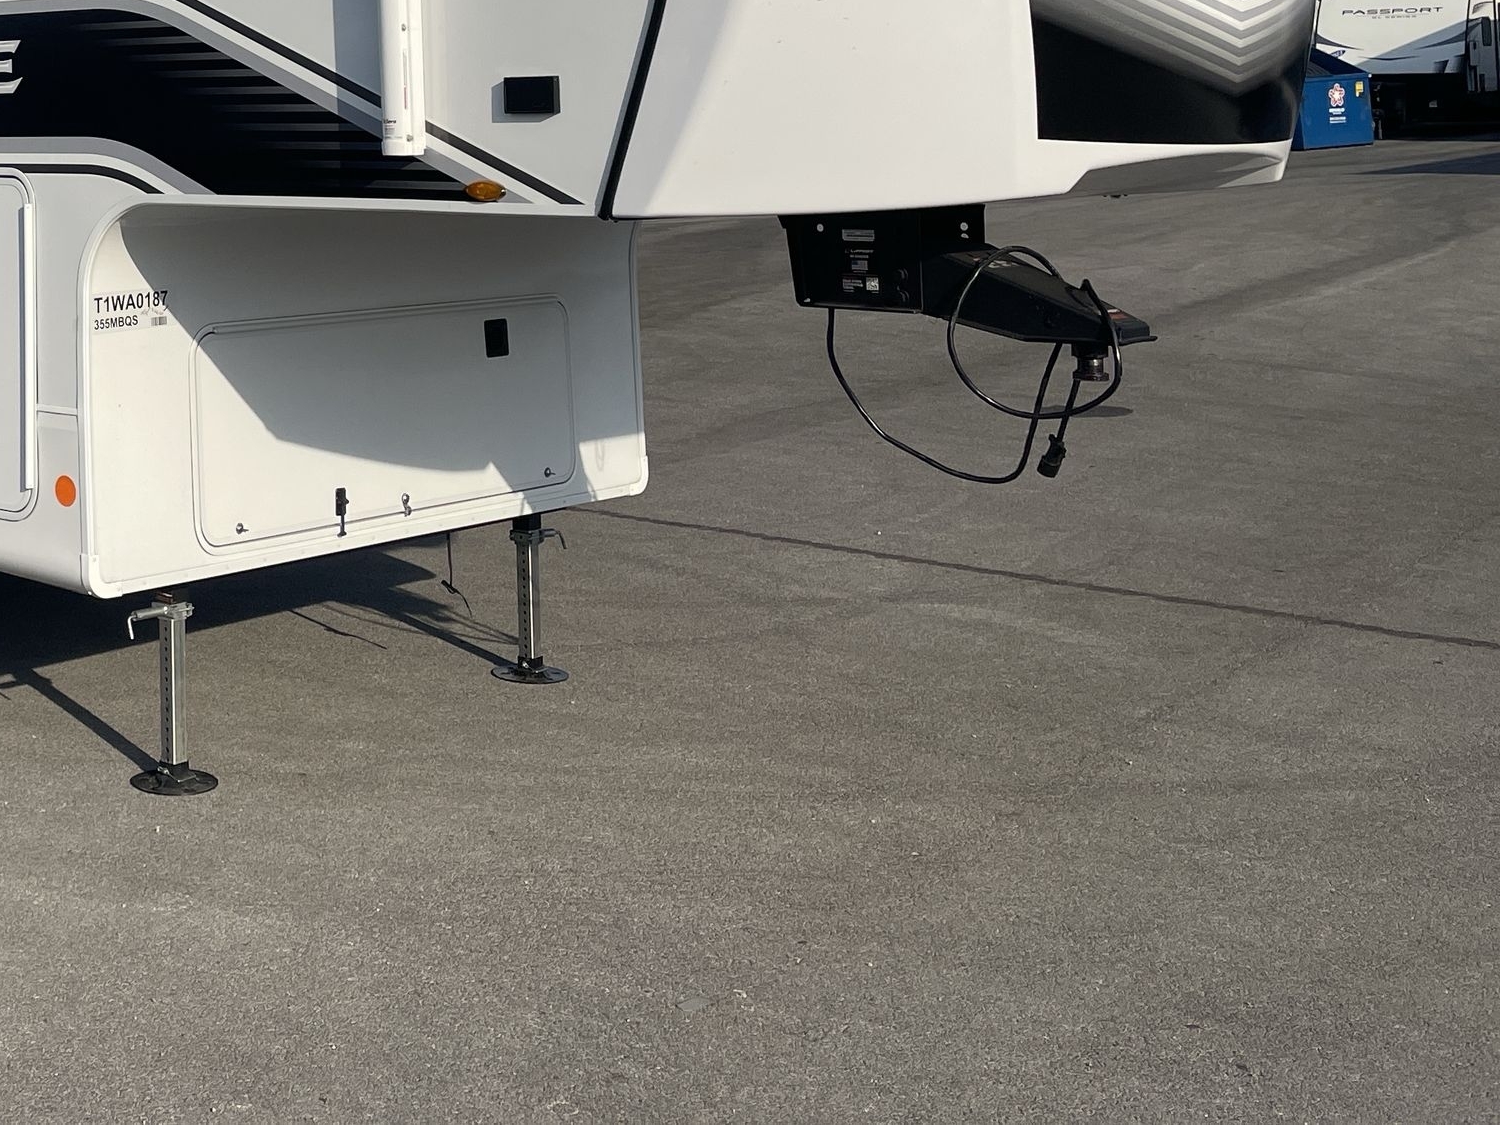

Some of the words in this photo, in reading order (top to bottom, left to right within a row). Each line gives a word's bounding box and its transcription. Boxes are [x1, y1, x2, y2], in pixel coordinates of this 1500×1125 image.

[1342, 6, 1443, 16] PASSPORT
[93, 290, 168, 314] T1WA0187
[94, 315, 139, 331] 355MBQS
